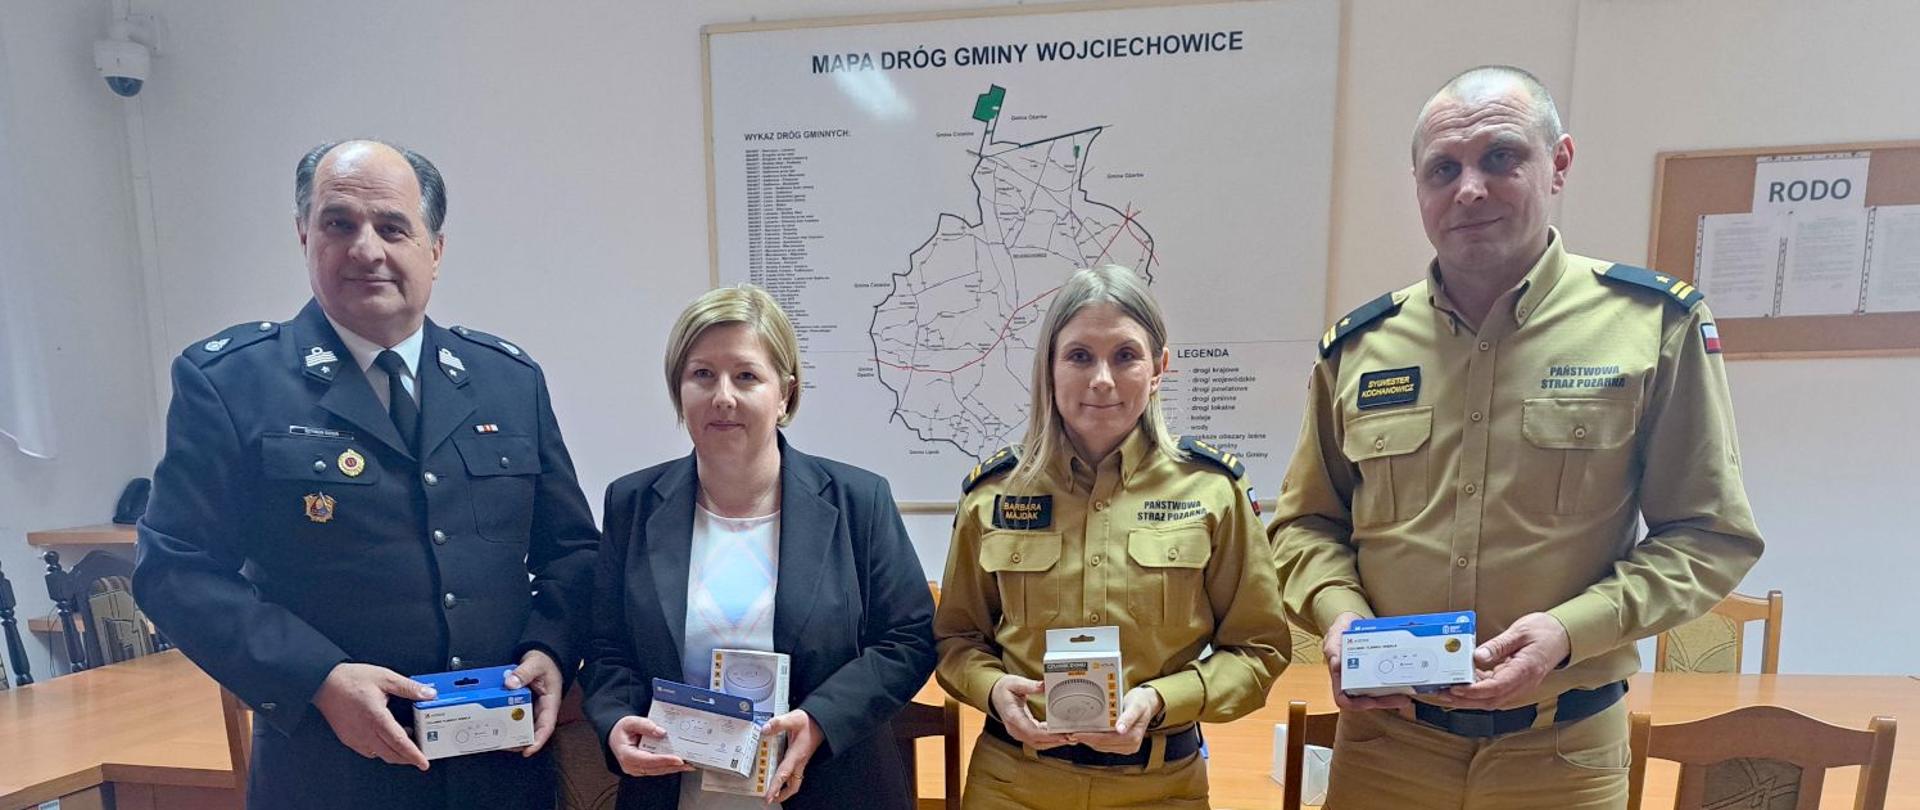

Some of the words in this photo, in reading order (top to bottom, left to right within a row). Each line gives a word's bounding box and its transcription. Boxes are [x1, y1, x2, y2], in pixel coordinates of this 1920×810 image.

[812, 51, 875, 74] MAPA
[881, 44, 947, 71] DRÓG
[954, 43, 1028, 67] GMINY
[1036, 30, 1244, 61] WOJCIECHOWICE
[744, 132, 774, 141] WYKAZ
[776, 130, 801, 140] DRÓG
[1768, 178, 1852, 203] RODO
[1177, 348, 1230, 358] LEGENDA
[1549, 364, 1619, 376] PAŃSTWOWA
[1541, 377, 1574, 389] STRAŻ
[1361, 384, 1414, 398] KOCHANOWICZ
[1003, 502, 1042, 511] BARBARA
[1144, 499, 1201, 510] PAŃSTWOWA
[1005, 511, 1038, 520] MAJDAK
[1137, 511, 1166, 521] STRAŻ
